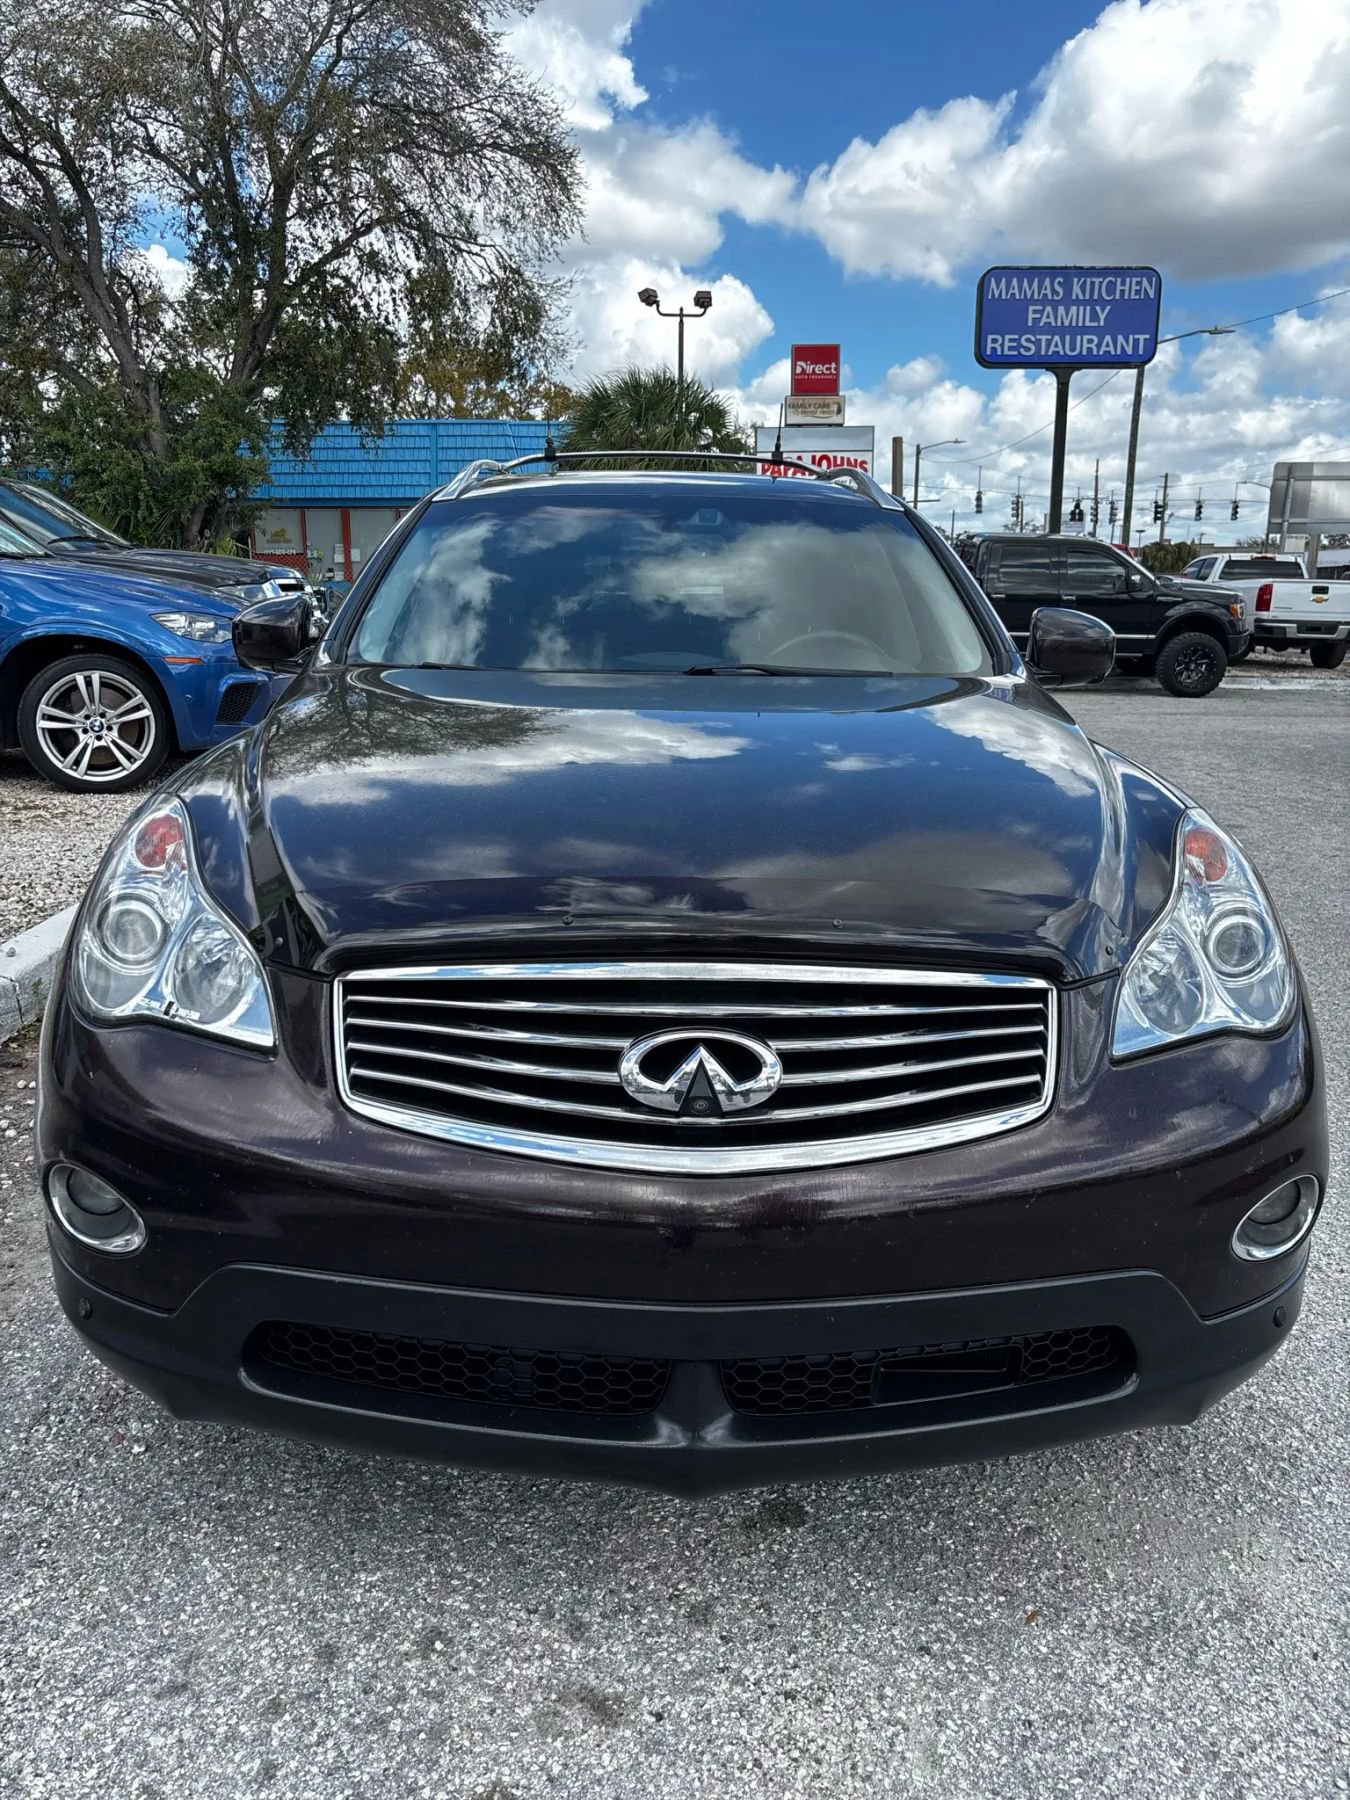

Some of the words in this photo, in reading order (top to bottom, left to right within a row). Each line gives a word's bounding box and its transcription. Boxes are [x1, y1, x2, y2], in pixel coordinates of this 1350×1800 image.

[988, 277, 1064, 300] MAMAS
[1071, 277, 1156, 300] KITCHEN
[1027, 305, 1111, 327] FAMILY
[986, 334, 1150, 356] RESTAURANT
[795, 361, 837, 374] Direct
